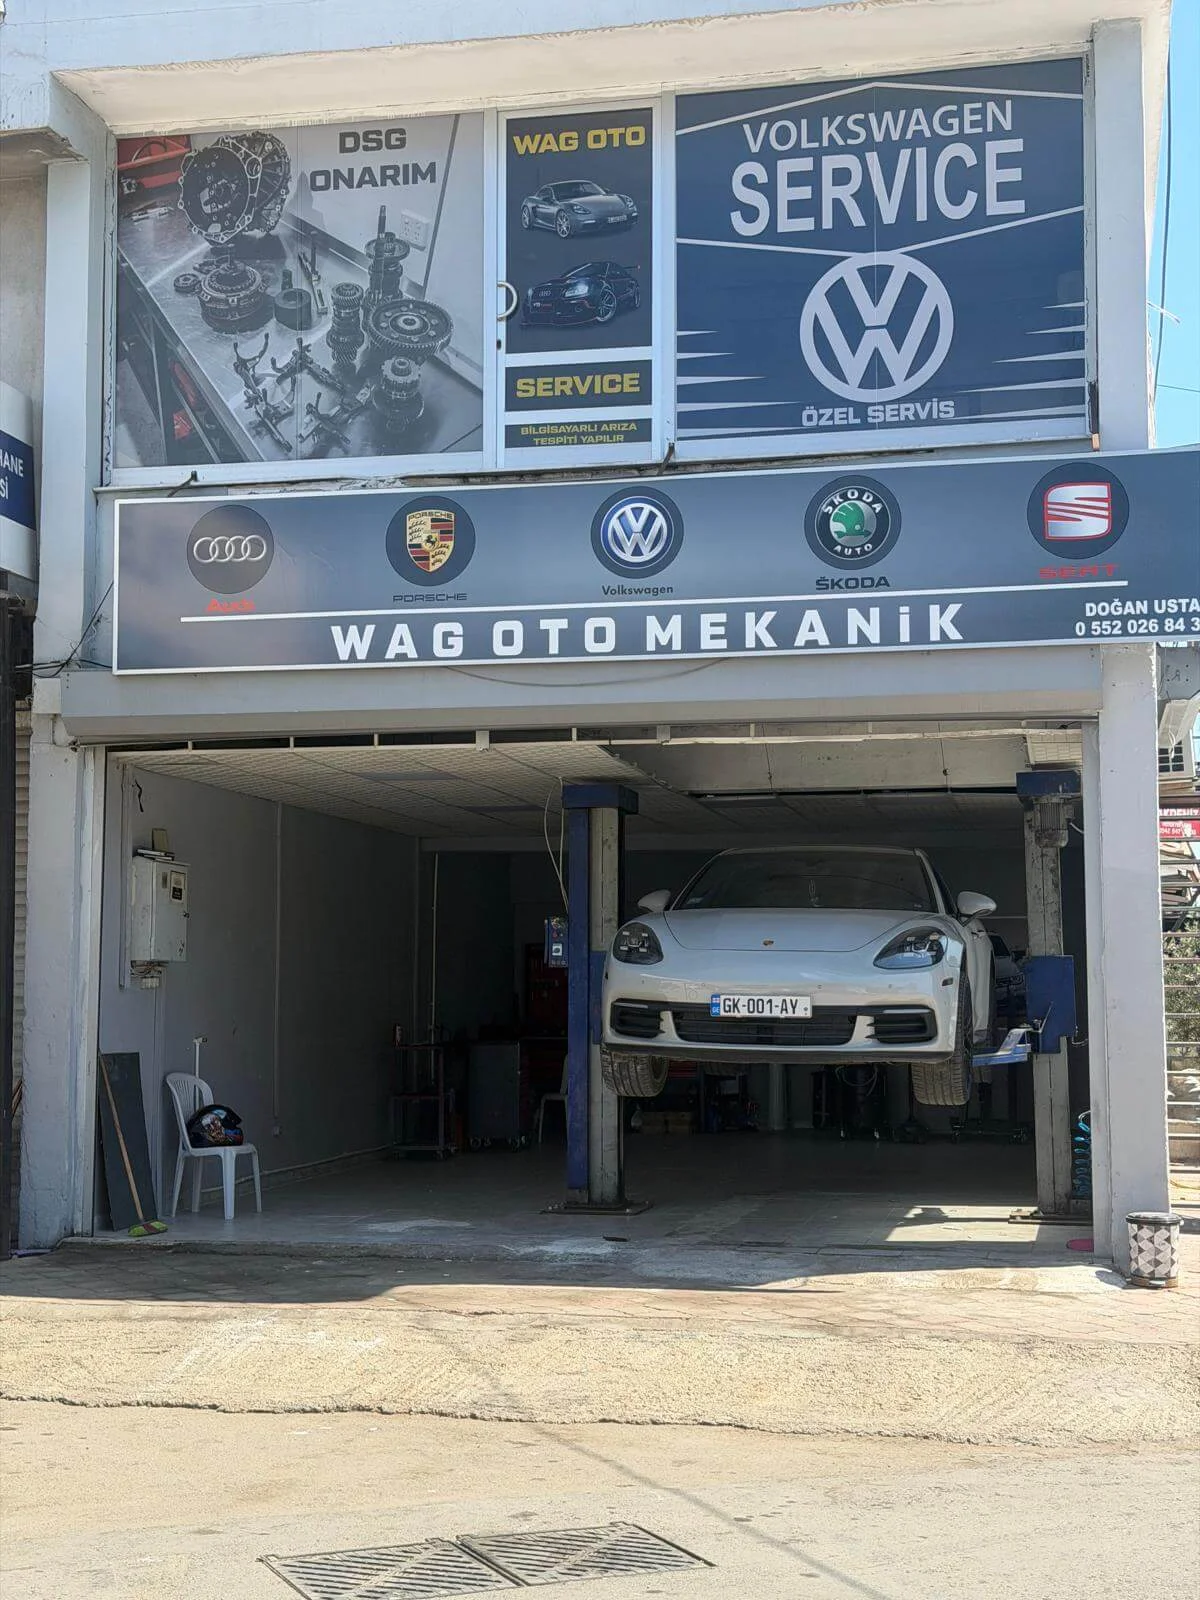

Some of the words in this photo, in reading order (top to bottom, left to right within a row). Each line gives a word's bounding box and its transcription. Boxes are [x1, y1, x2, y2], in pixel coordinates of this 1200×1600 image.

[742, 99, 1012, 153] VOLKSWAGEN
[339, 128, 407, 154] DSG
[513, 131, 579, 155] WAG
[587, 126, 646, 149] OTO
[309, 161, 437, 192] ONARIM
[730, 138, 1026, 236] SERVICE
[516, 372, 640, 398] SERVICE
[802, 405, 861, 427] ÖZEL
[867, 398, 955, 423] SERVİS
[520, 423, 598, 436] BİLGİSAYARLI
[600, 422, 638, 433] ARIZA
[580, 434, 625, 444] YAPILIR
[408, 511, 453, 521] PORSCHE
[833, 542, 873, 556] AUTO
[1039, 563, 1119, 579] SEAT
[601, 584, 674, 597] Volkswagen
[815, 575, 891, 591] ŠKODA
[392, 592, 468, 603] PORSCHE
[1085, 598, 1148, 617] DOĞAN
[1153, 597, 1200, 614] USTA
[1075, 621, 1086, 636] 0
[1090, 620, 1122, 636] 552
[1127, 619, 1159, 634] 026
[1164, 617, 1186, 632] 84
[330, 621, 464, 661] WAG
[492, 616, 616, 657] OTO
[723, 998, 799, 1015] GK-001-AY
